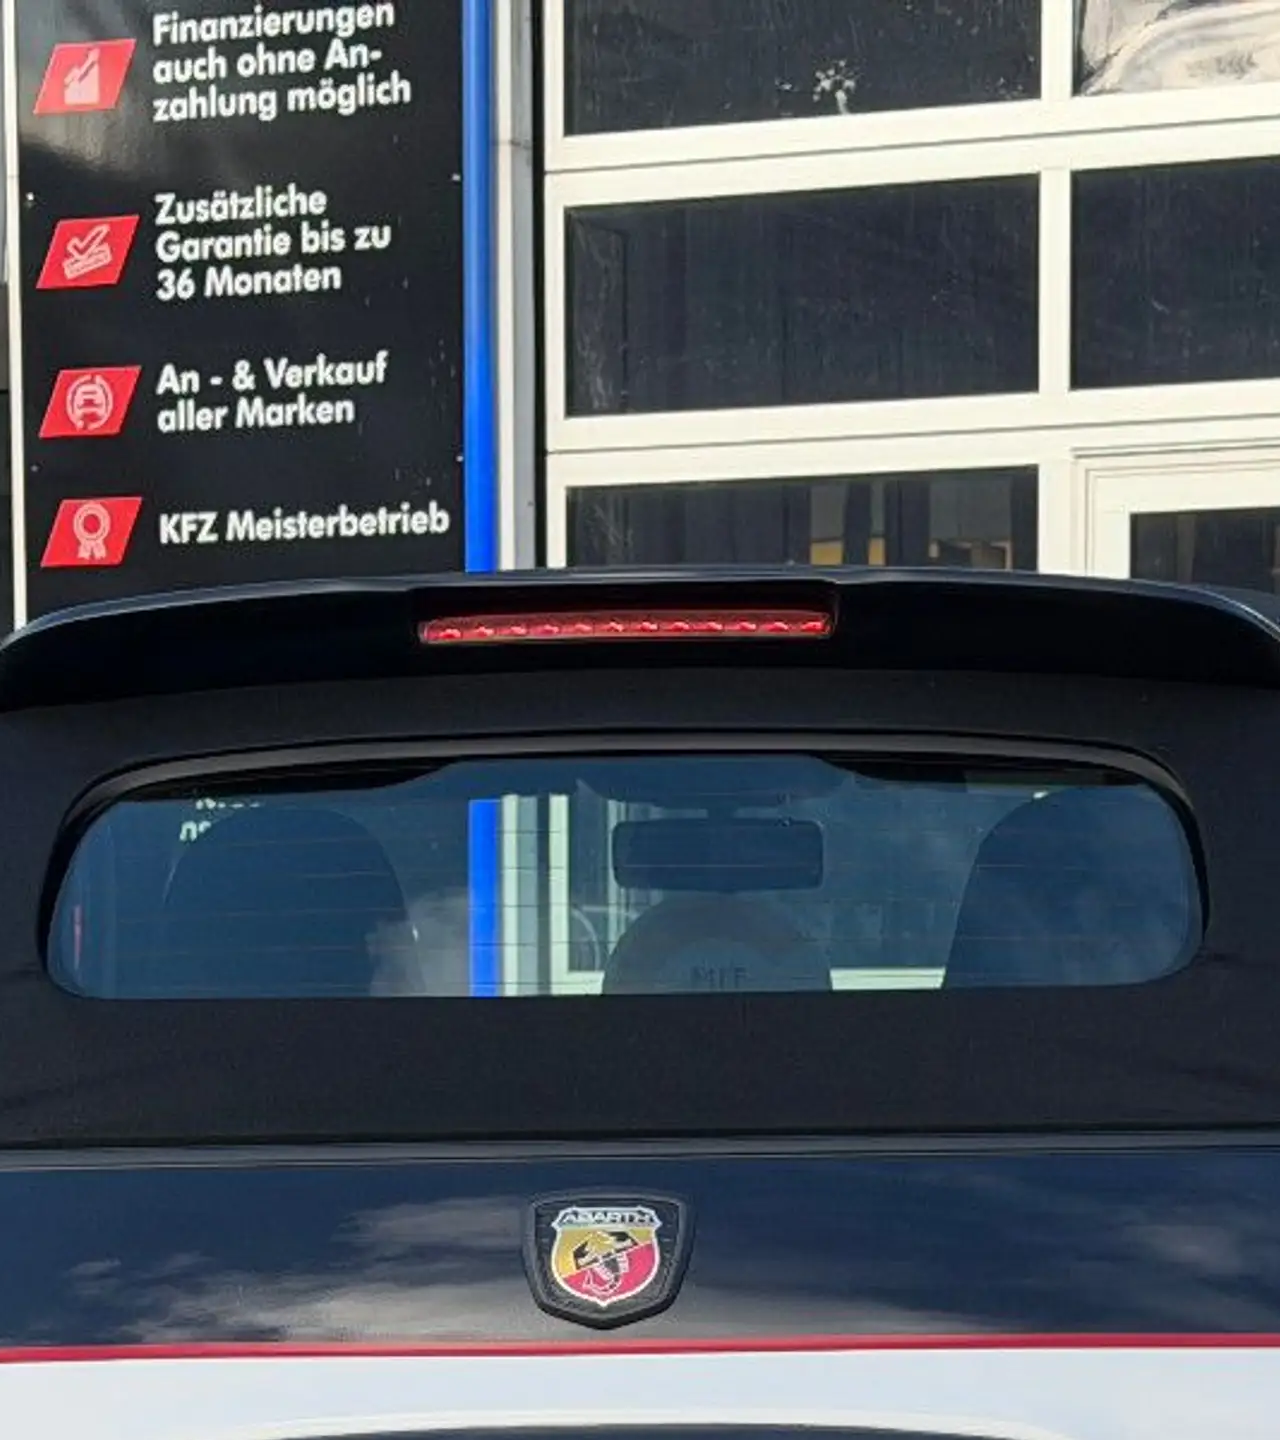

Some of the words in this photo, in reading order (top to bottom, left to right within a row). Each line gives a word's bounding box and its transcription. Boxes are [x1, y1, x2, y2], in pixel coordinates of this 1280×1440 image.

[152, 2, 395, 46] Finanzierungen
[153, 48, 226, 85] auch
[237, 43, 315, 78] ohne
[324, 37, 382, 70] An-
[153, 82, 277, 122] zahlung
[287, 70, 412, 112] möglich
[155, 184, 327, 226] Zusätzliche
[155, 225, 291, 263] Garantie
[301, 223, 344, 253] bis
[354, 225, 391, 250] zu
[156, 270, 193, 301] 36
[205, 264, 341, 299] Monaten
[156, 363, 199, 395] An
[232, 360, 255, 391] &
[264, 351, 389, 390] Verkauf
[157, 400, 227, 433] aller
[235, 393, 355, 428] Marken
[159, 512, 219, 545] KFZ
[225, 501, 451, 541] Meisterbetrieb
[561, 1211, 656, 1224] ABARTH
